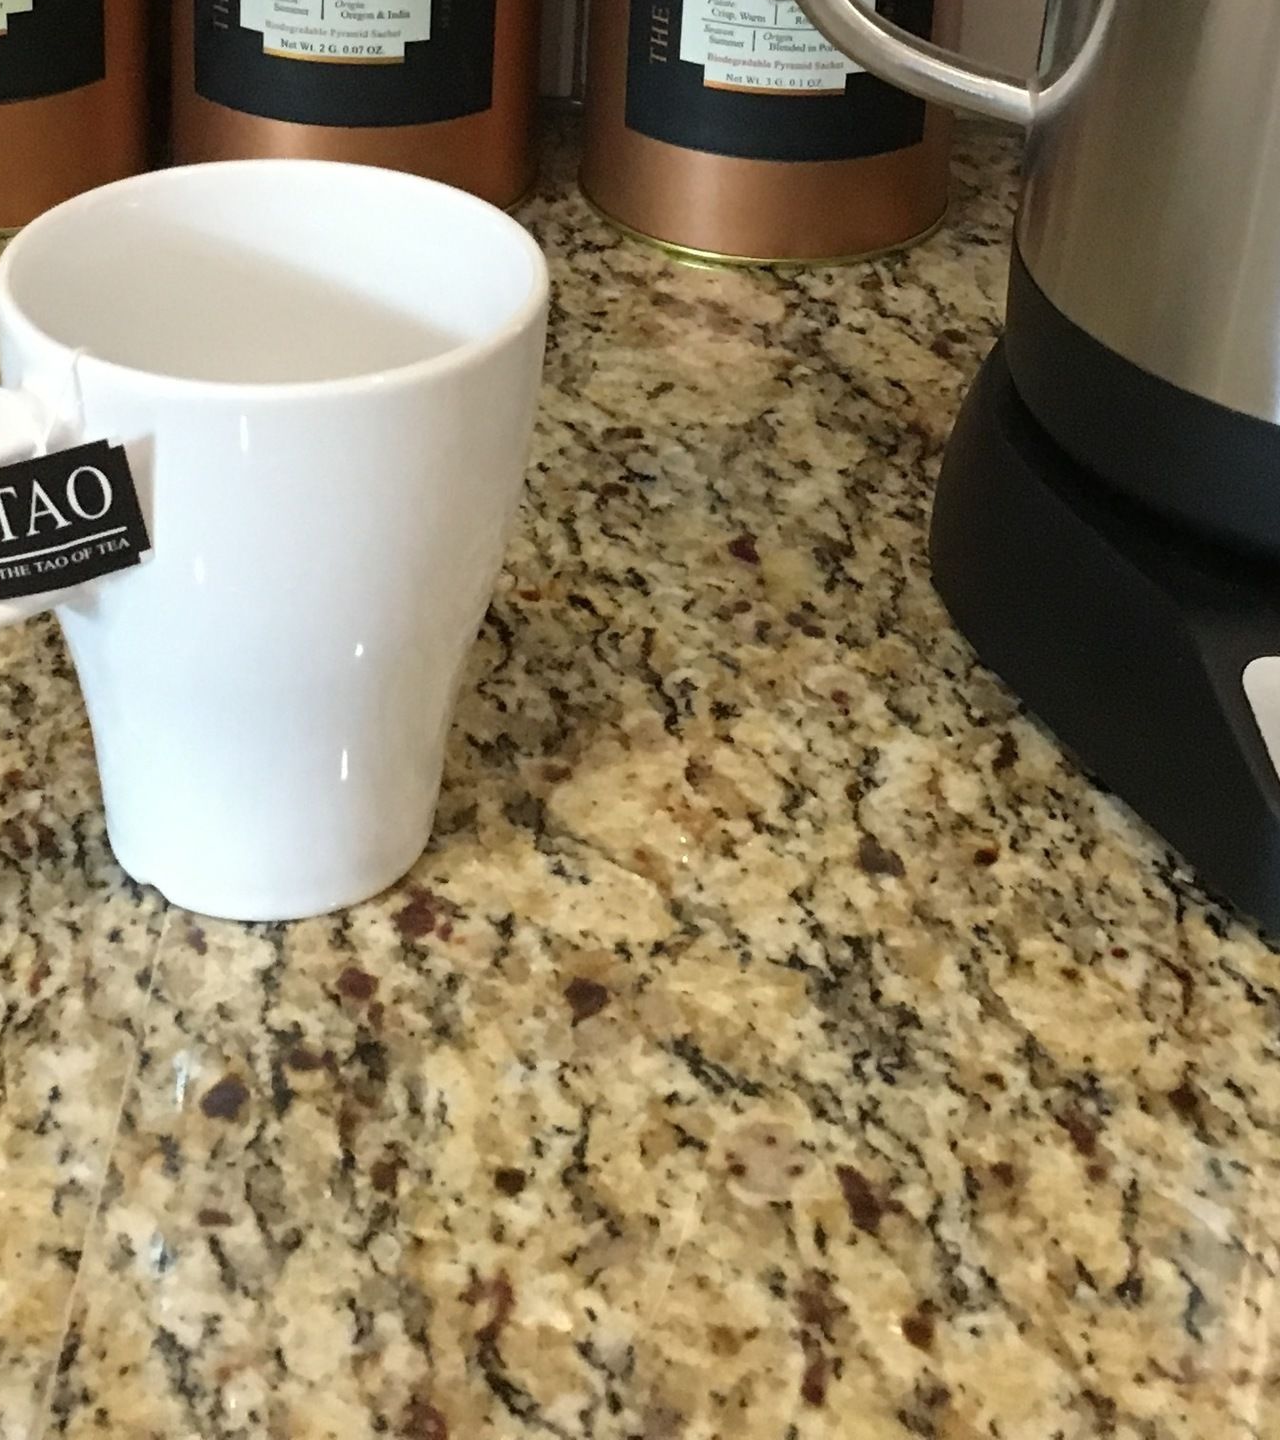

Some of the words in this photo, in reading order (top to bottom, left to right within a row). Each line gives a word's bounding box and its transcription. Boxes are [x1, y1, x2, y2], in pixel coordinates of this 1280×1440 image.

[341, 10, 374, 21] Oregon
[388, 10, 410, 18] India
[740, 13, 766, 22] Warm
[330, 29, 368, 38] Pyramid
[648, 4, 671, 65] THE
[280, 38, 297, 49] Net
[319, 44, 325, 52] 2
[343, 45, 363, 53] 0.07
[709, 37, 744, 47] Summer
[770, 43, 805, 51] Blended
[707, 53, 771, 67] Biodegradable
[775, 61, 812, 70] Pyramid
[726, 74, 743, 84] Net
[0, 564, 31, 580] THE
[34, 557, 69, 573] TAO
[71, 549, 93, 562] OF
[98, 538, 130, 556] TEA
